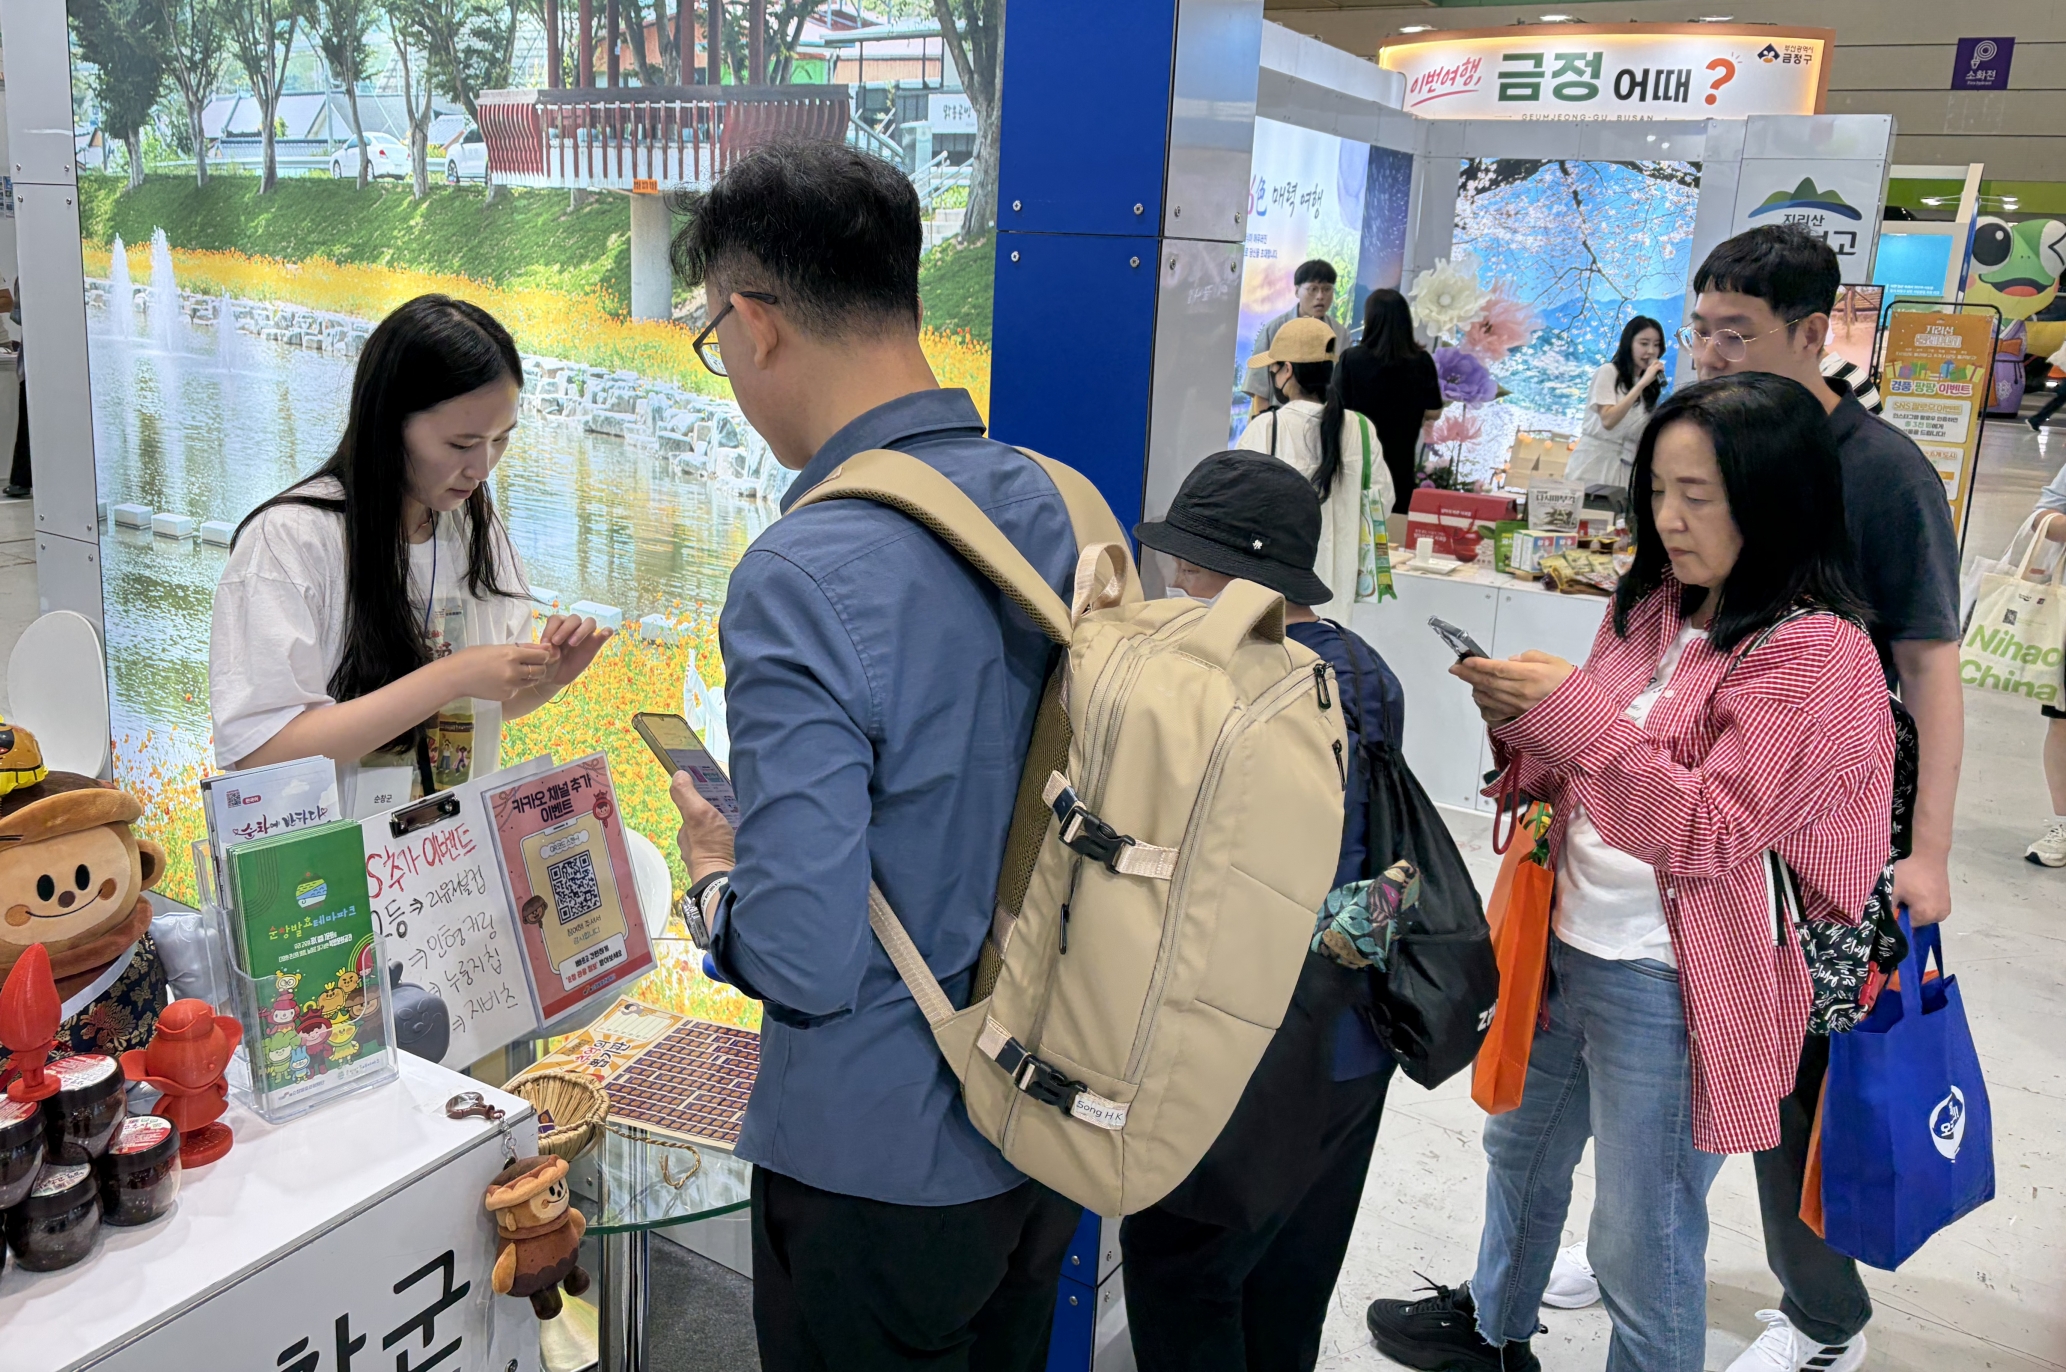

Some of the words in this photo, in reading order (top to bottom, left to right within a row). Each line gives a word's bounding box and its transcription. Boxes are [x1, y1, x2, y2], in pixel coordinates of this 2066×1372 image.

[1782, 53, 1812, 65] 금정구
[1784, 44, 1814, 54] 부산광역시
[1497, 51, 1604, 102] 금정
[1613, 67, 1692, 103] 어때
[1965, 70, 1996, 81] 소화전
[1616, 114, 1655, 122] BUSAN
[1272, 181, 1298, 218] 매력
[1300, 182, 1324, 220] 여행
[1783, 214, 1826, 227] 지리산
[1891, 380, 1912, 392] 경품
[1914, 381, 1937, 394] 팡팡
[1938, 383, 1972, 396] 이벤트
[1894, 401, 1911, 411] SNS
[1936, 404, 1962, 415] 이벤트
[1966, 624, 2062, 668] Nihao
[1960, 659, 2058, 703] China
[374, 794, 393, 804] 순창군
[511, 790, 547, 814] 카카오
[547, 781, 571, 802] 채널
[570, 773, 592, 793] 추가
[282, 805, 322, 828] 반하다
[540, 798, 575, 823] 이벤트
[422, 822, 477, 867] 이벤트
[426, 924, 466, 959] 인형
[462, 911, 498, 940] 키링
[1076, 1100, 1103, 1118] Song
